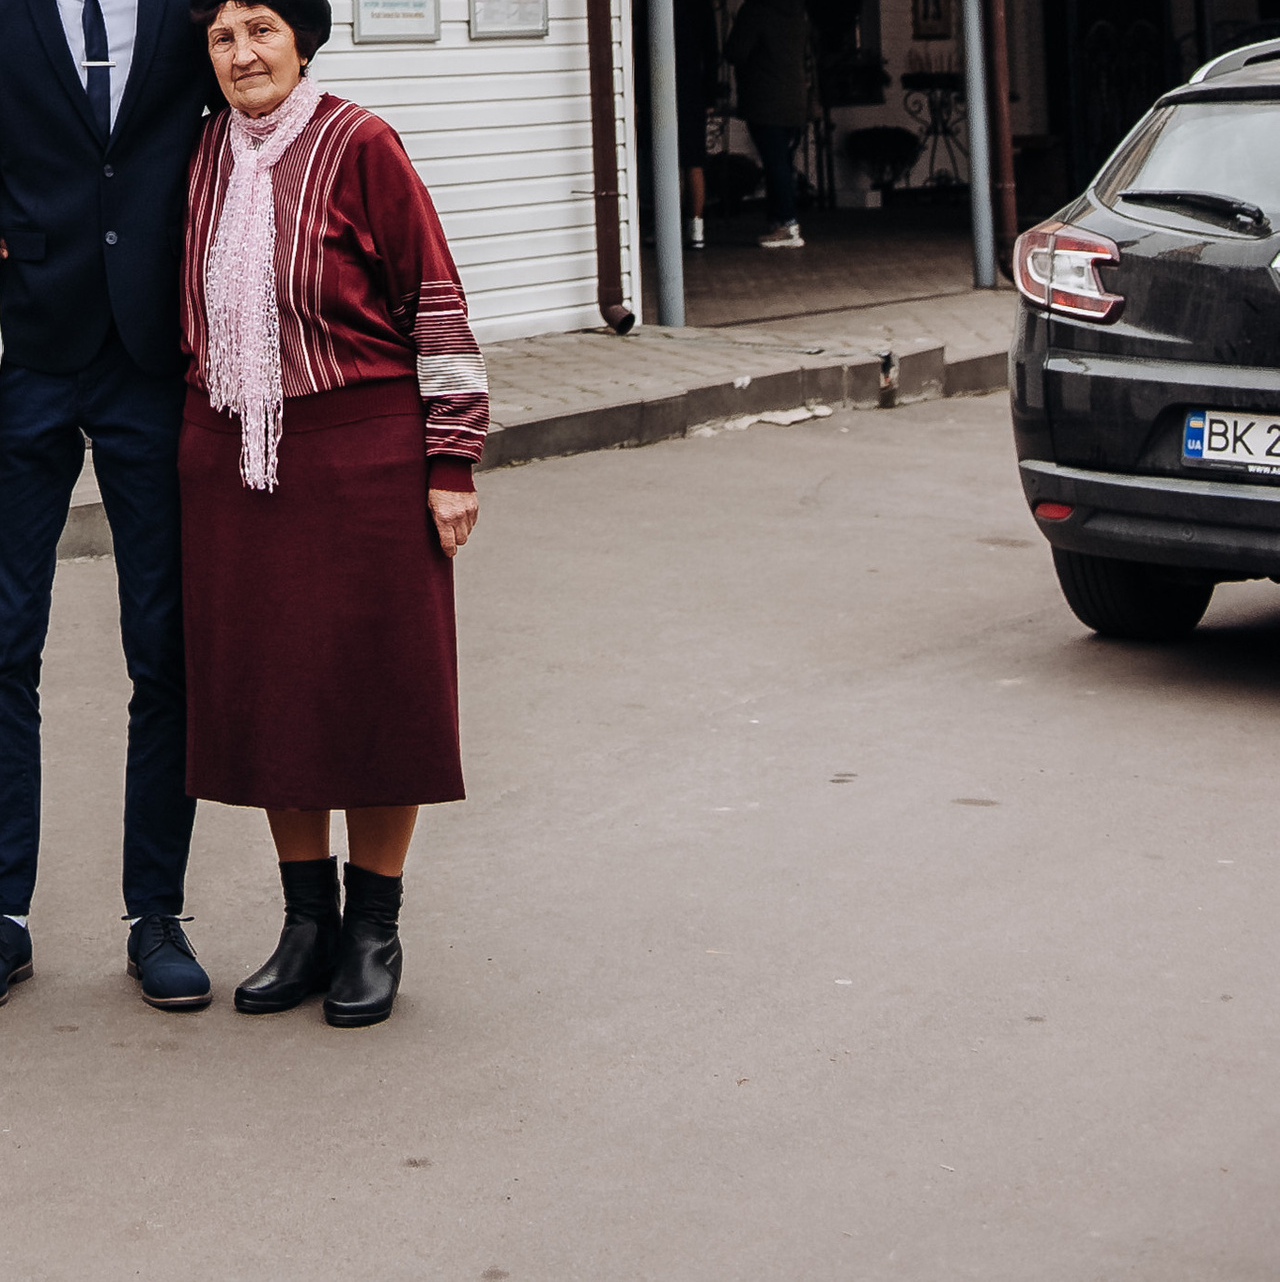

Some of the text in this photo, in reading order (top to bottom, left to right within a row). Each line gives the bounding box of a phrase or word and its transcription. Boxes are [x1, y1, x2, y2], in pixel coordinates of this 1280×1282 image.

[1187, 439, 1202, 450] UA
[1207, 419, 1280, 457] BK 2
